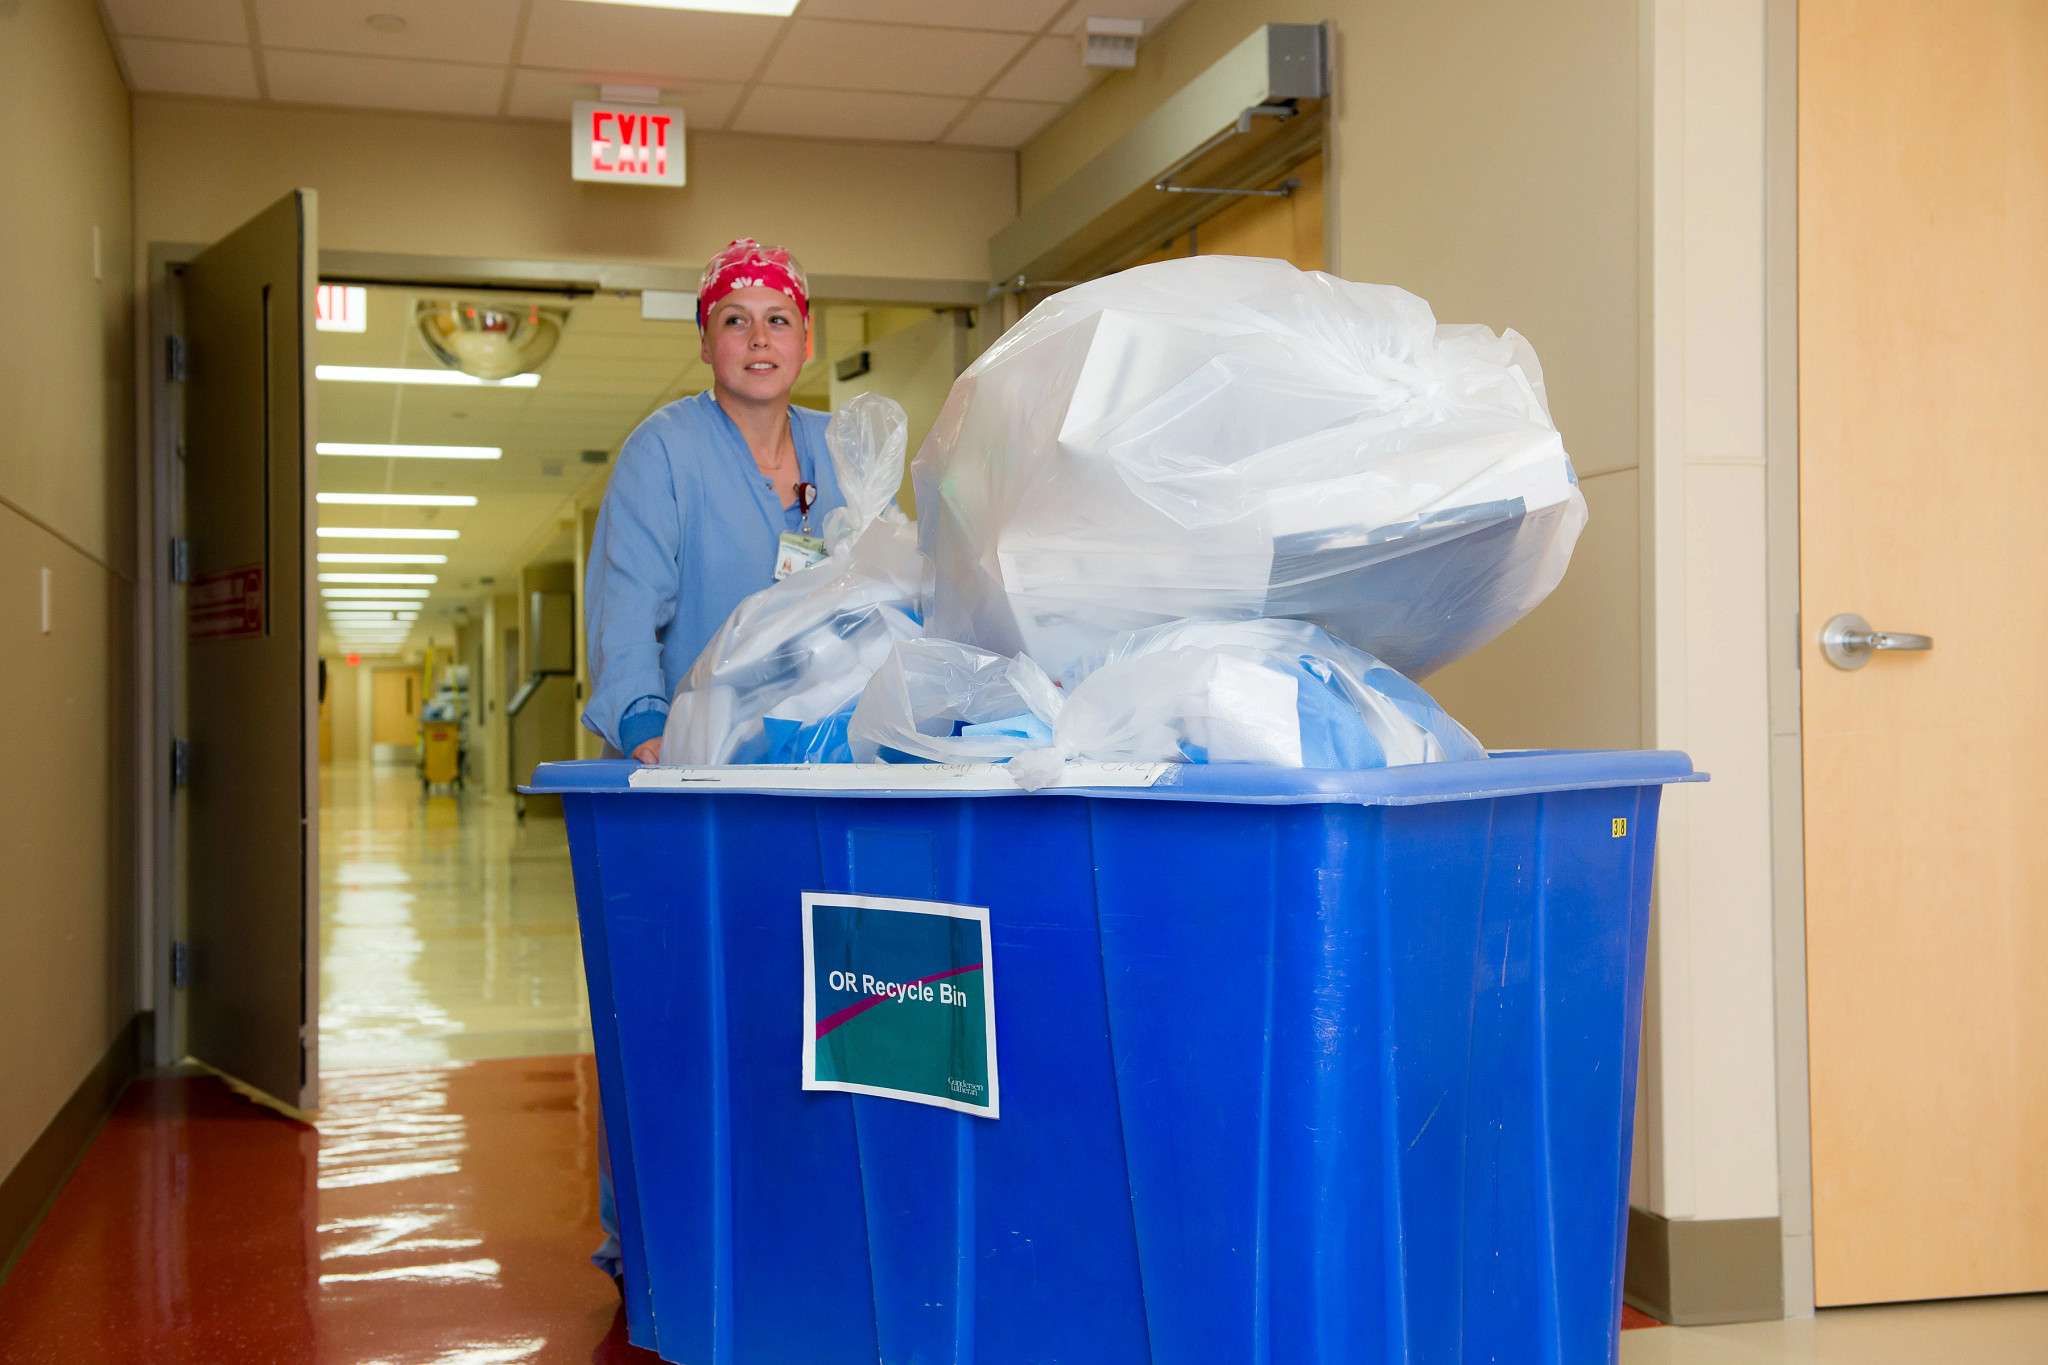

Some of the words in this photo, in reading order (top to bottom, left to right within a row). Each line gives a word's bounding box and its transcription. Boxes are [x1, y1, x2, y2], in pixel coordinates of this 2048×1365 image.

[592, 111, 671, 176] EXIT
[1613, 819, 1626, 836] 38
[829, 970, 858, 993] OR
[862, 973, 934, 1004] Recycle
[939, 983, 967, 1008] Bin
[947, 1076, 984, 1092] Gundersen
